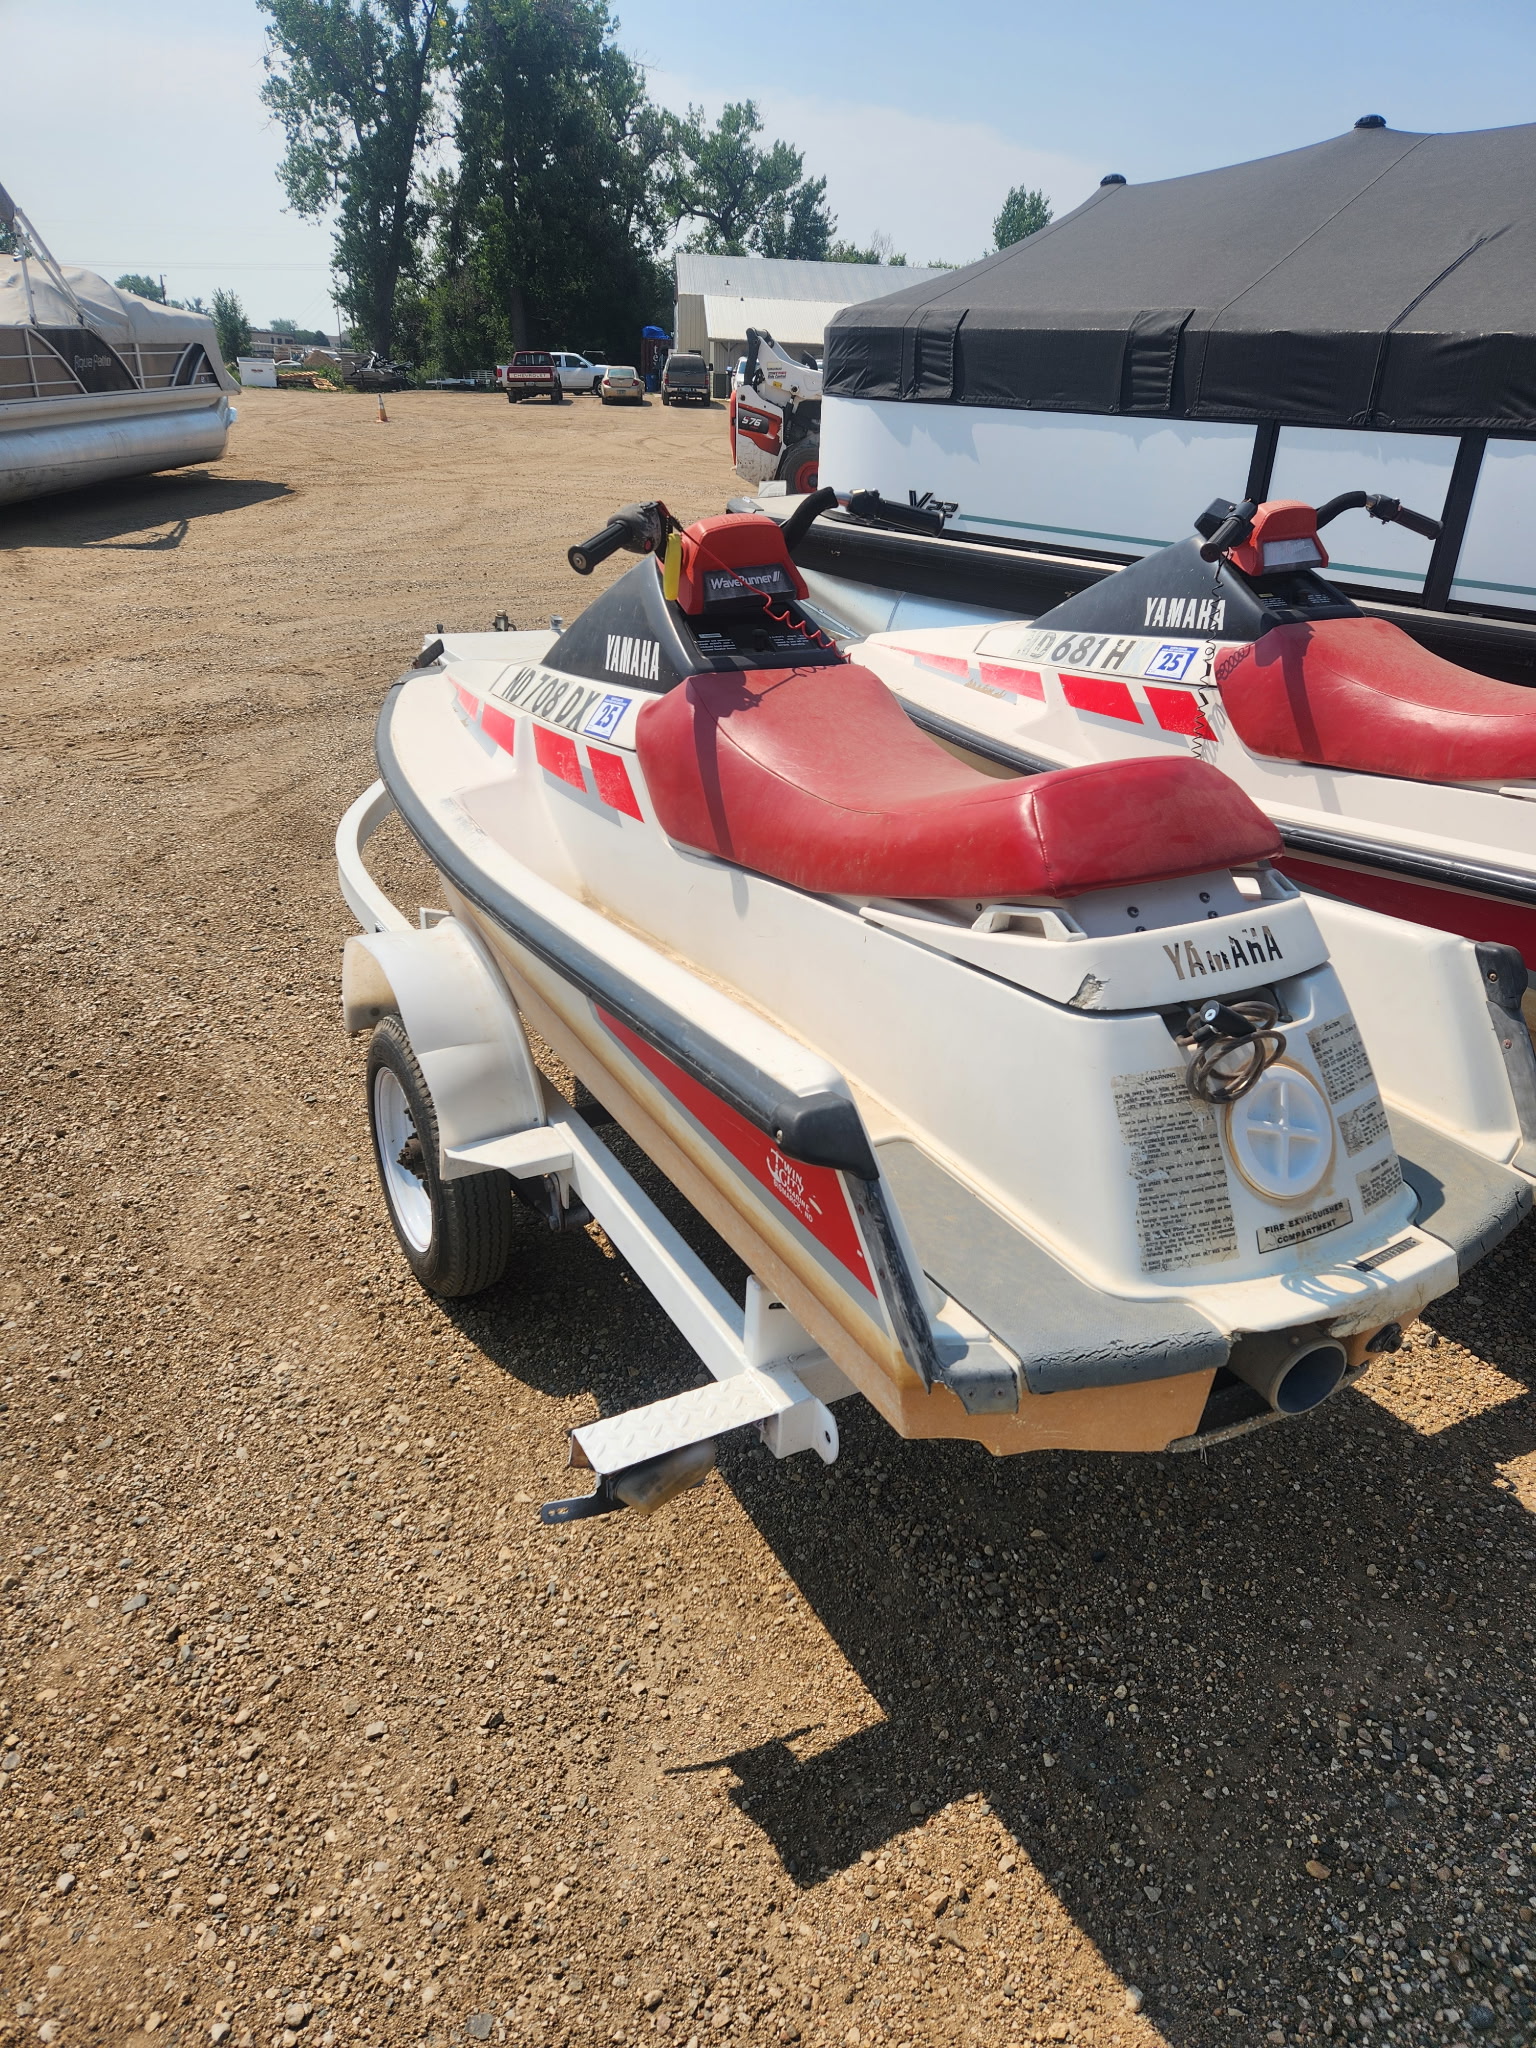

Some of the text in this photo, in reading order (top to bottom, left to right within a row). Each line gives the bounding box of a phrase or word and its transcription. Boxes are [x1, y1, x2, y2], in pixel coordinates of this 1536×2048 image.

[741, 416, 763, 427] S76
[711, 574, 772, 590] WaveRunner
[1144, 597, 1226, 631] YAMAHA
[605, 634, 660, 681] YAMAHA
[1050, 634, 1110, 667] 681
[1157, 652, 1184, 672] 25
[501, 666, 601, 732] ND 708 DX
[594, 704, 619, 728] 25
[1149, 1072, 1177, 1081] WARNING
[1265, 1202, 1344, 1235] FIRE EXTINGUISHER
[1277, 1218, 1337, 1244] COMPARTMENT
